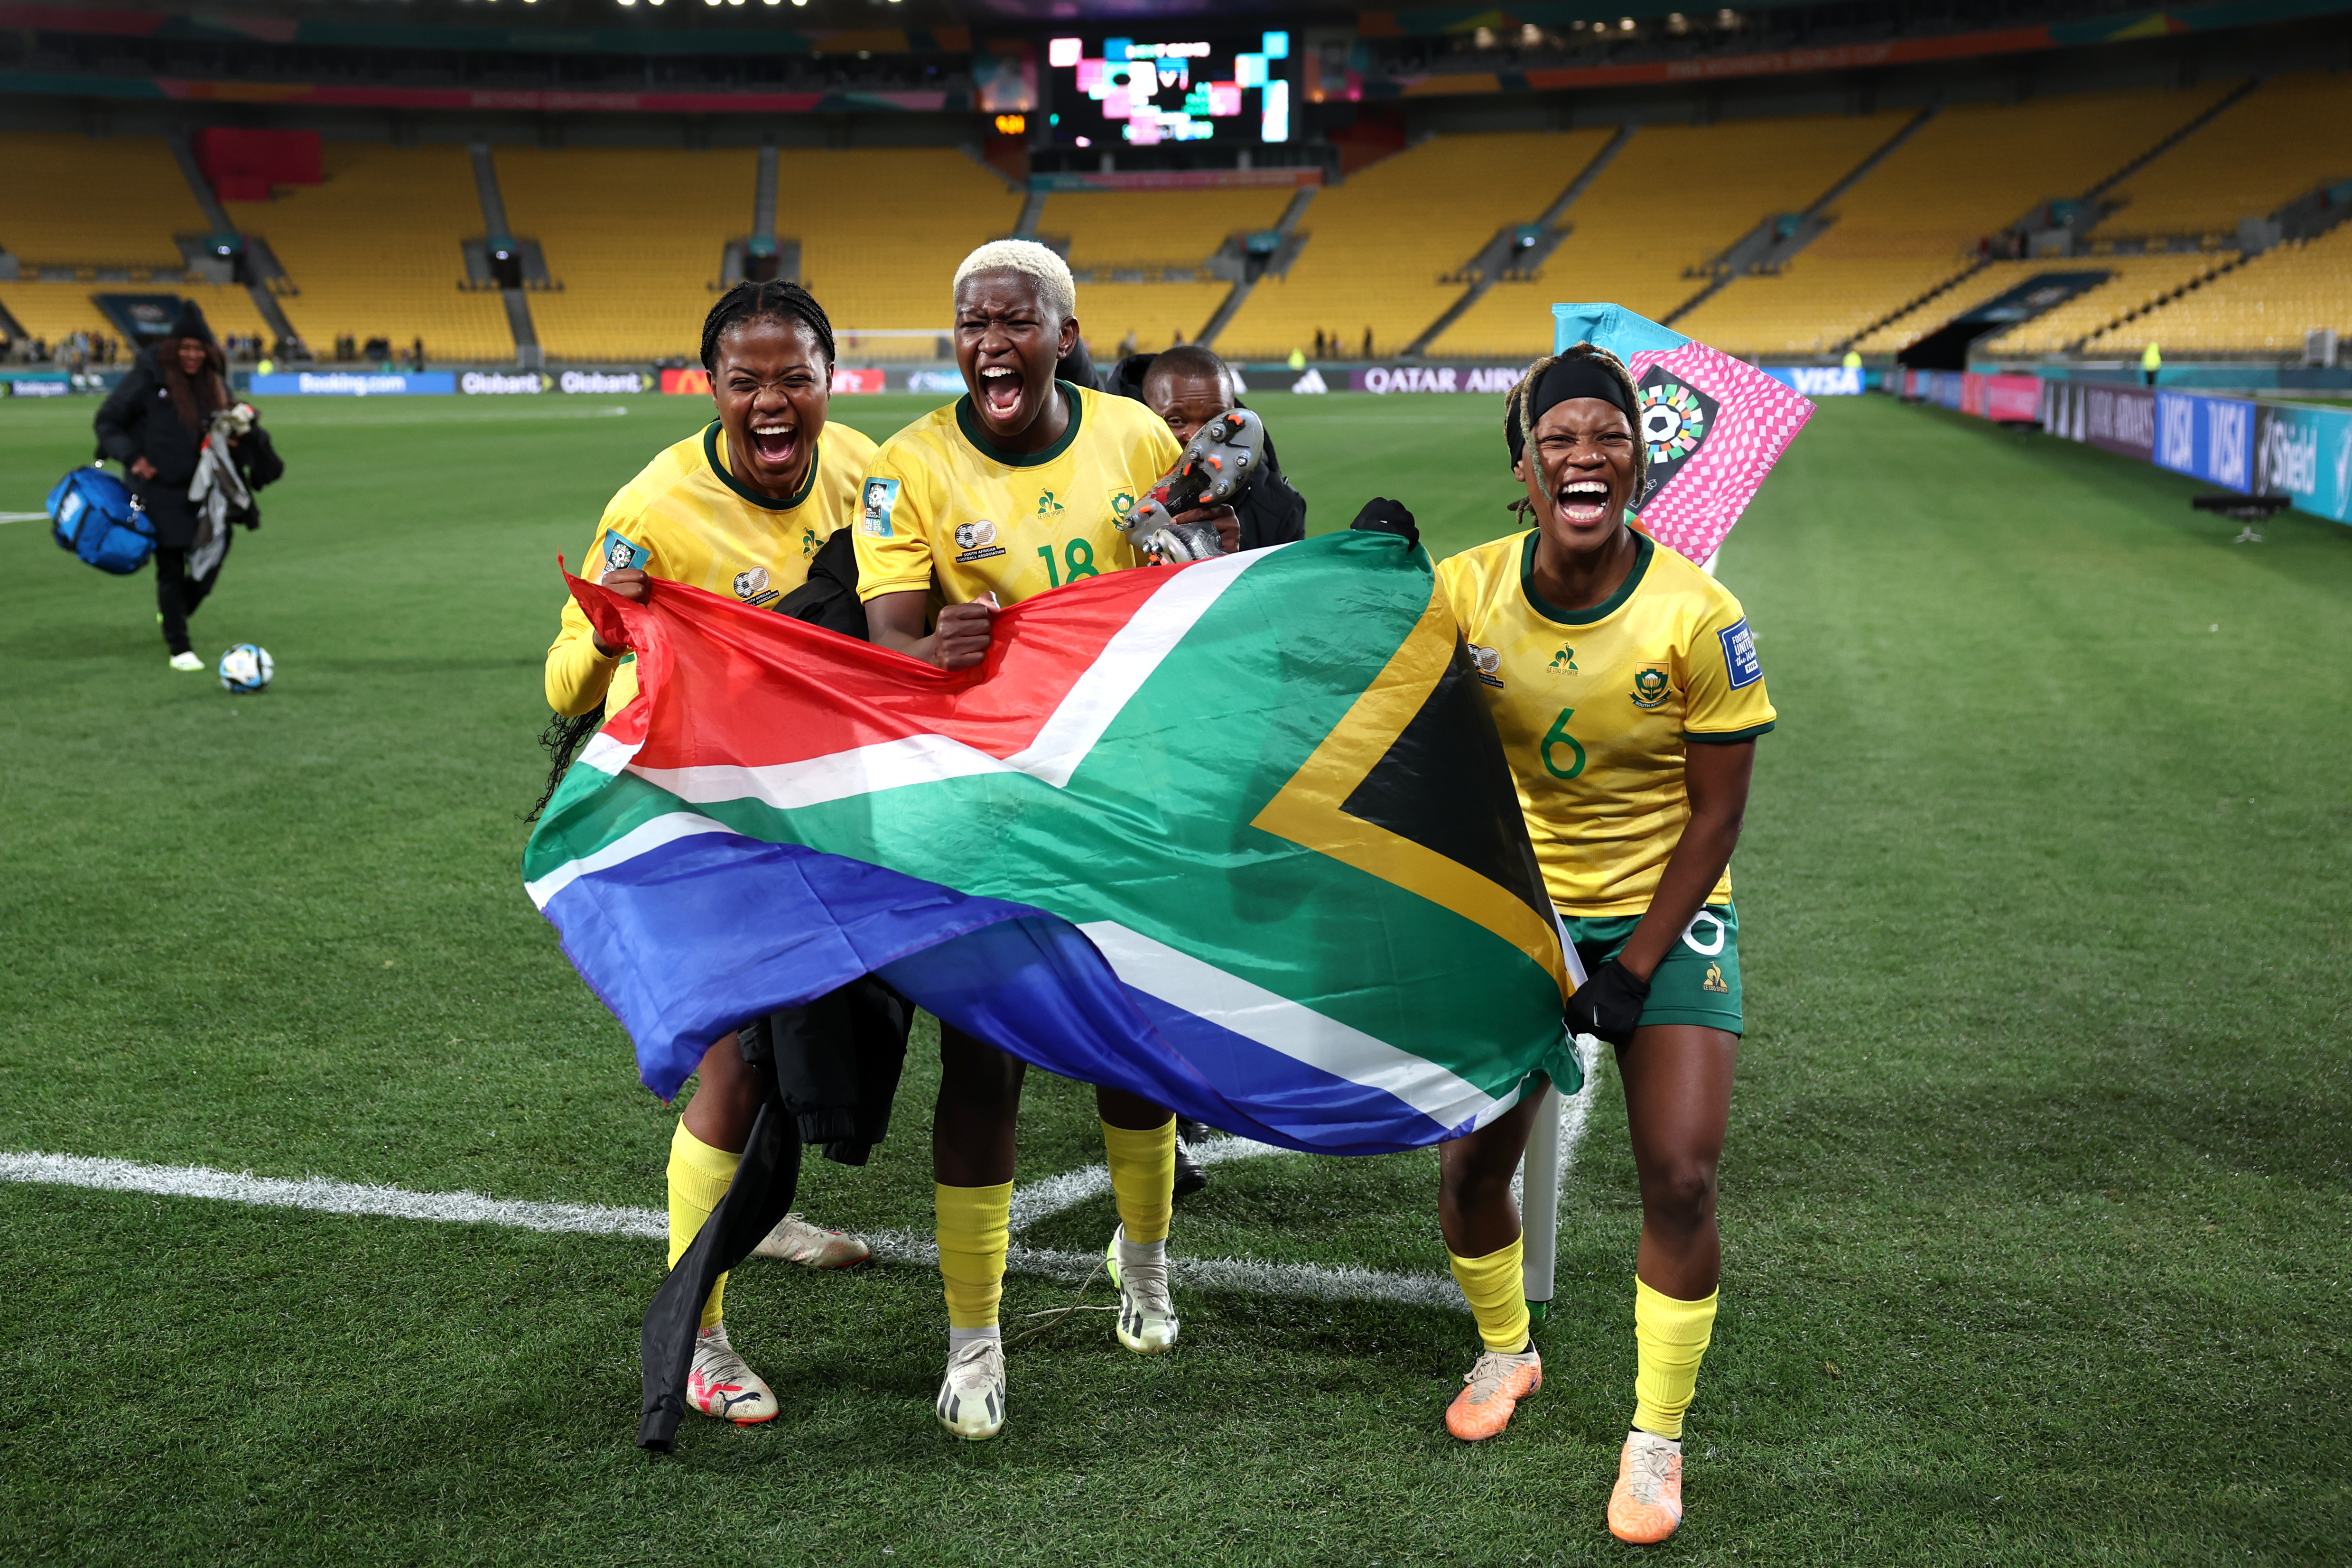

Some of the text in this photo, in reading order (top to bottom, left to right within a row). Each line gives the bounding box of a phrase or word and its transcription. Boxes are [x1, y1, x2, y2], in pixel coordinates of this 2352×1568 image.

[1365, 367, 1457, 394] QATAR
[1791, 367, 1860, 395] VISA
[2207, 400, 2246, 488] VISA
[2270, 420, 2317, 495] Shield
[978, 549, 1005, 558] ASSOCIATION
[1037, 538, 1100, 589] 18
[756, 591, 771, 600] AFRICAN
[756, 592, 778, 604] ASSOCIATION
[1735, 656, 1746, 666] the
[1747, 663, 1756, 671] FIFA
[1650, 698, 1666, 707] AFRICA
[1541, 708, 1586, 779] 6
